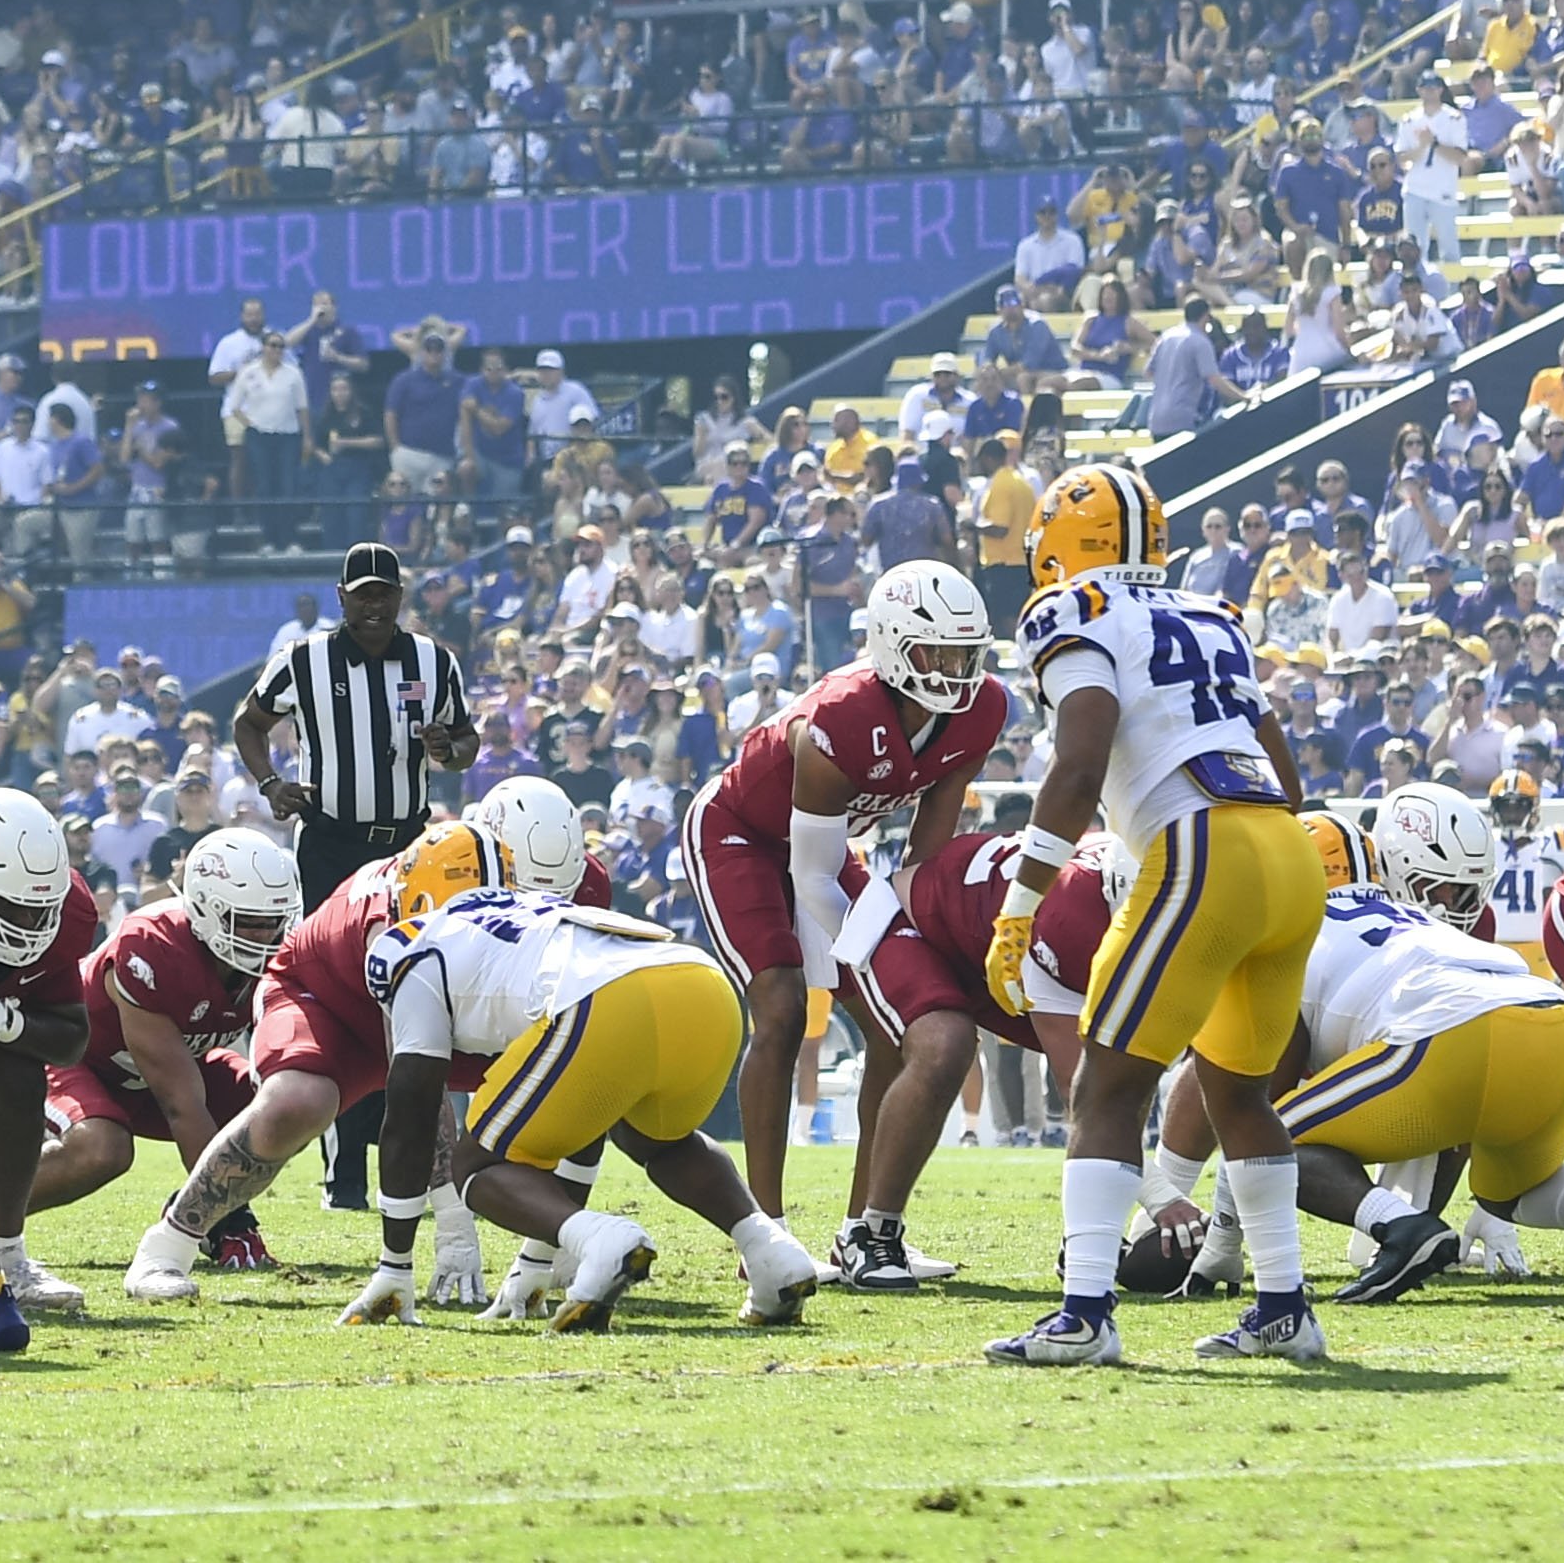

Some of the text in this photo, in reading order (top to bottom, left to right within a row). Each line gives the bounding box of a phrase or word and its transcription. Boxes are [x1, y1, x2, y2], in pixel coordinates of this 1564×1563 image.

[48, 212, 318, 301] LOUDER
[346, 194, 631, 290] LOUDER
[667, 177, 959, 274] LOUDER
[1104, 570, 1163, 582] TIGERS
[1148, 607, 1261, 728] 42
[334, 682, 347, 697] S
[871, 725, 888, 758] C
[1492, 869, 1536, 914] 41
[1259, 1315, 1296, 1348] NIKE
